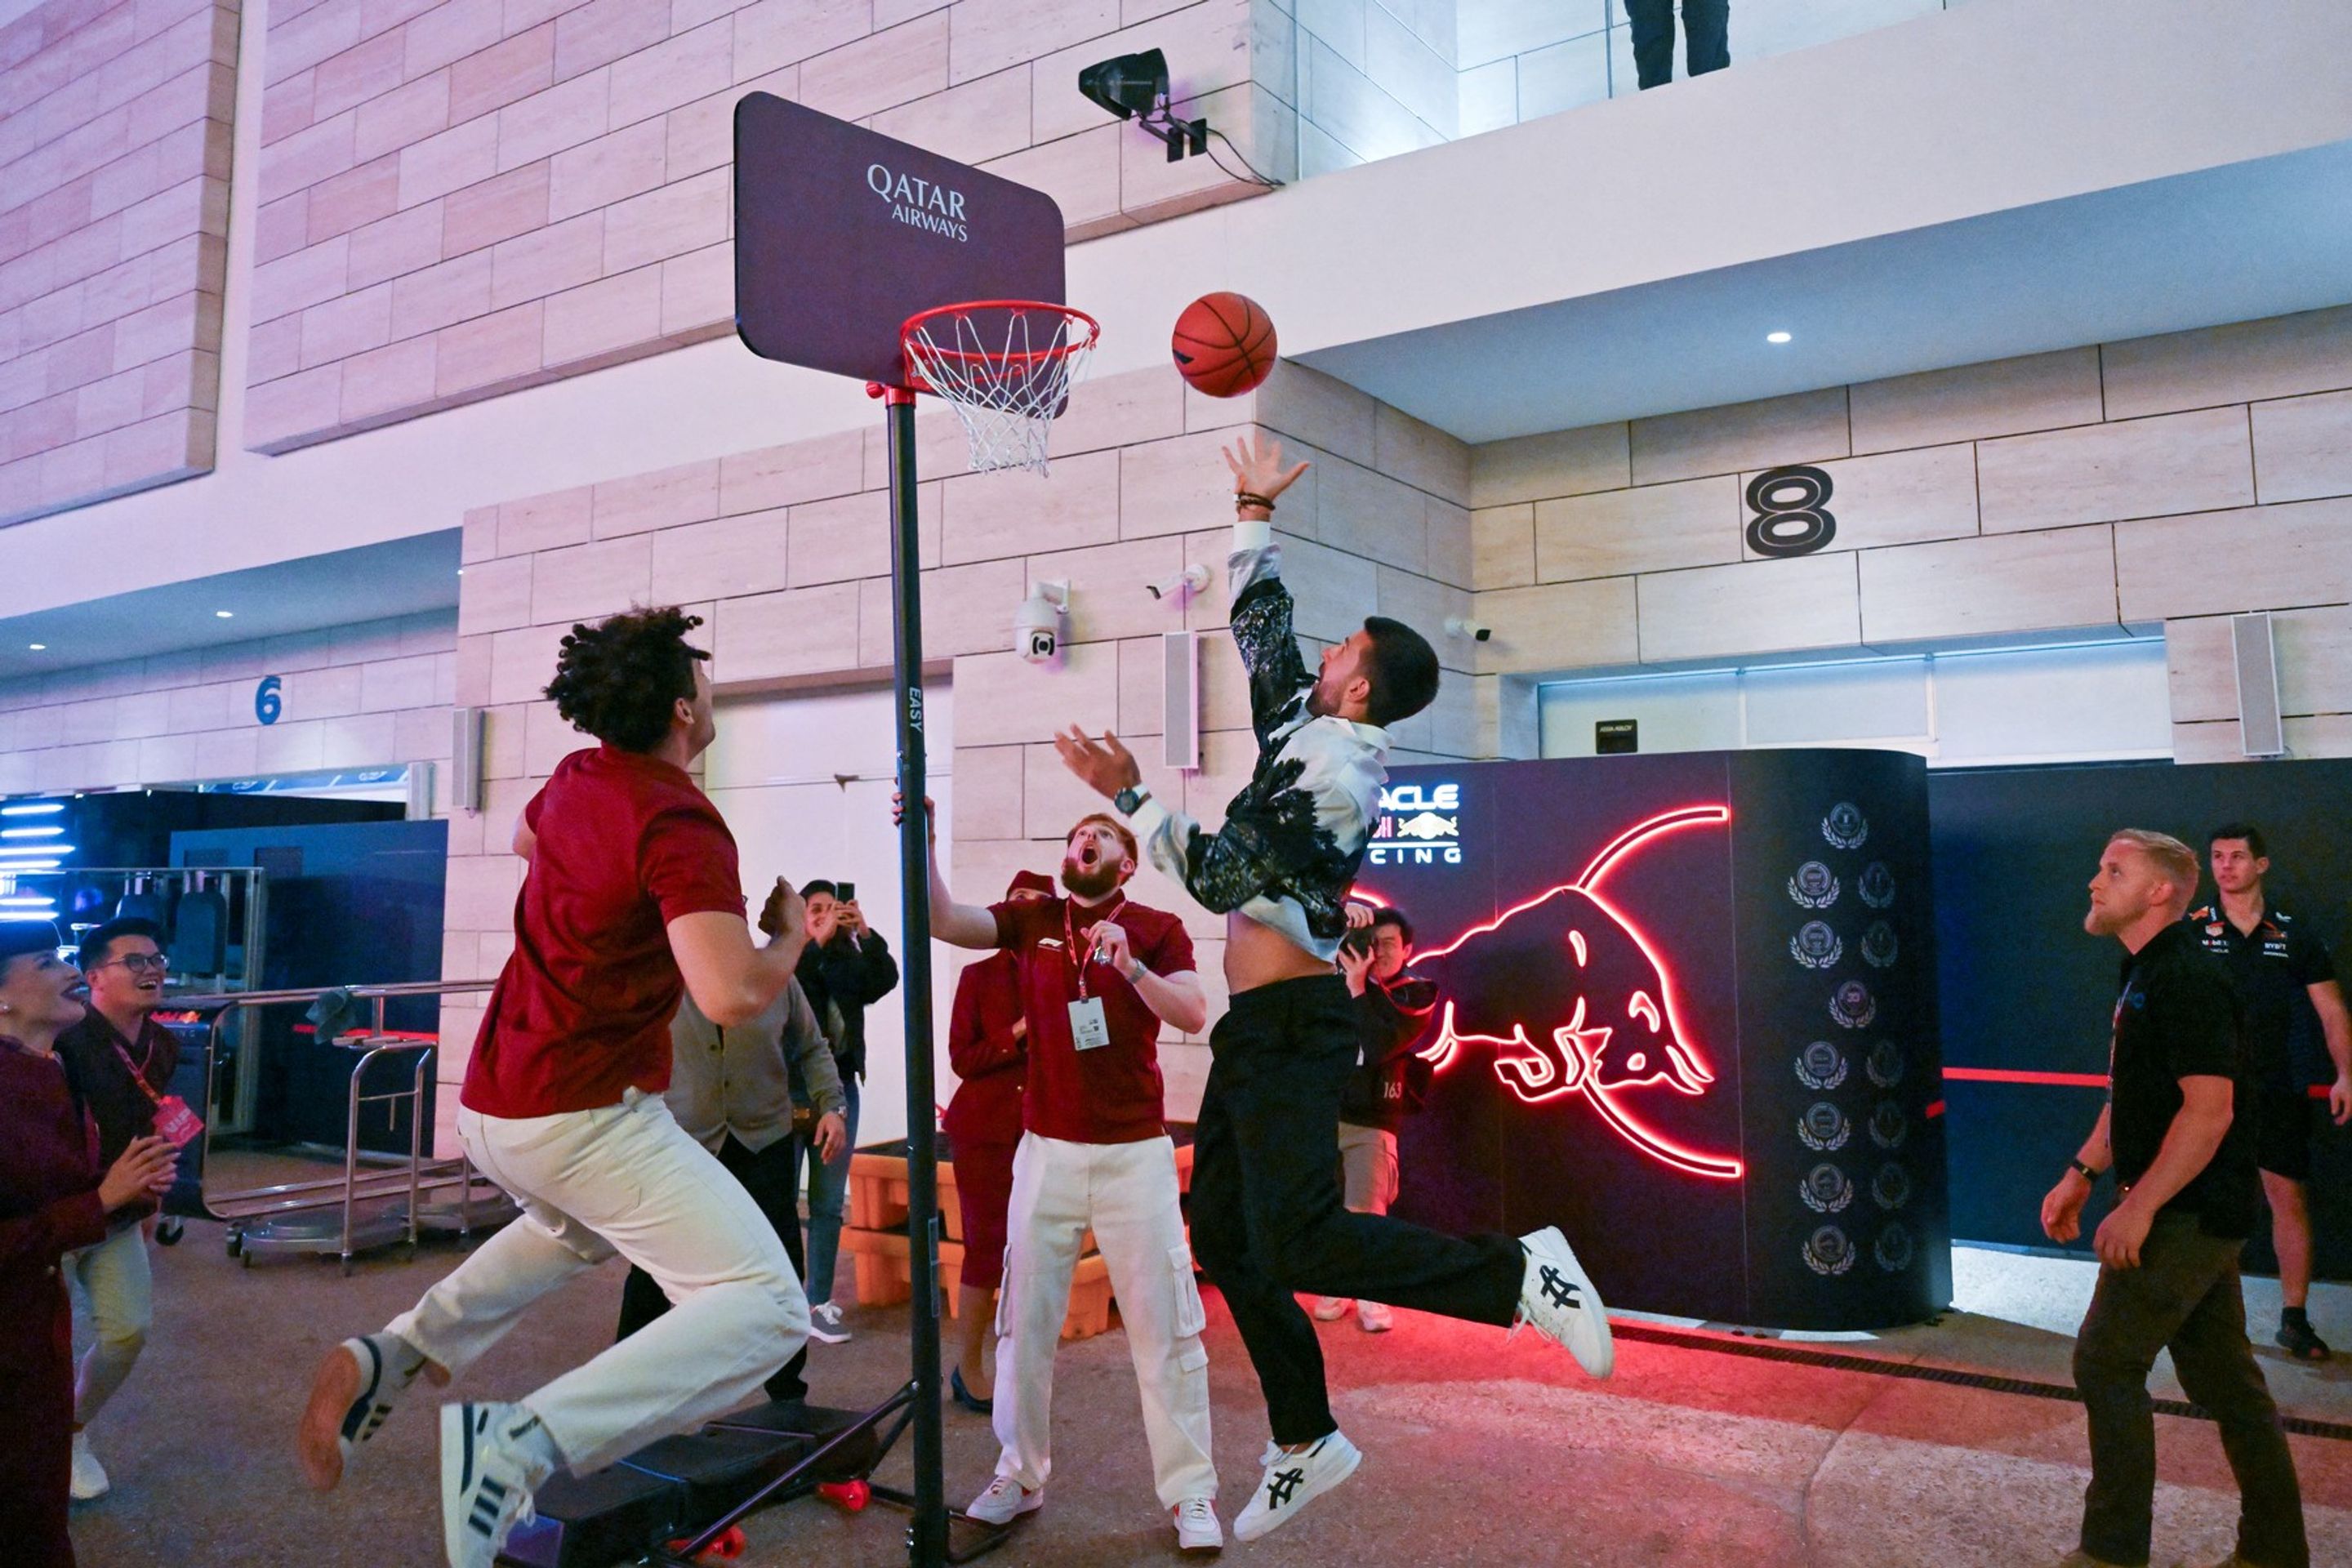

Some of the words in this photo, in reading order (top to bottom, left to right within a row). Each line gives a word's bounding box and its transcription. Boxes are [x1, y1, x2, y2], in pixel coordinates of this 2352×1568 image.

[867, 163, 966, 221] QATAR
[892, 203, 968, 243] AIRWAYS
[1745, 465, 1837, 558] 8
[255, 675, 282, 726] 6
[909, 686, 923, 733] EASY
[1383, 1081, 1402, 1099] 163
